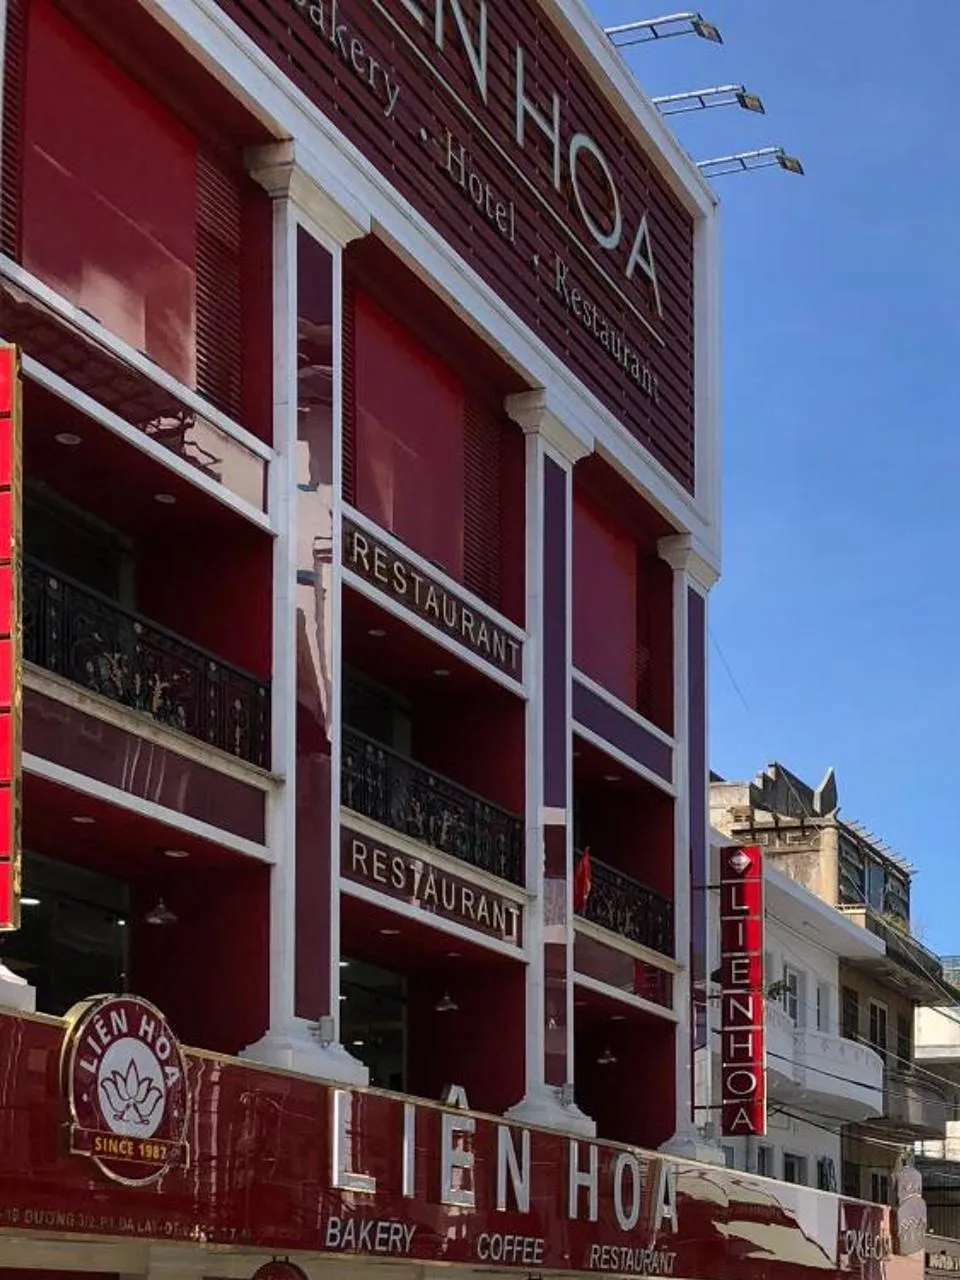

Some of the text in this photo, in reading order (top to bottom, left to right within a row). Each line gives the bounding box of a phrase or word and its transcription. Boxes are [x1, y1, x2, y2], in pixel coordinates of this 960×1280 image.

[294, 0, 660, 404] akery Hotel Restaurant
[515, 42, 663, 318] HOA
[353, 532, 521, 669] RESTAURANT
[352, 840, 521, 938] RESTAURANT
[138, 1014, 181, 1087] HOA
[94, 1137, 135, 1156] SINCE
[568, 1138, 678, 1234] HOA
[325, 1217, 678, 1275] BAKERY COFFEE RESTAURANT
